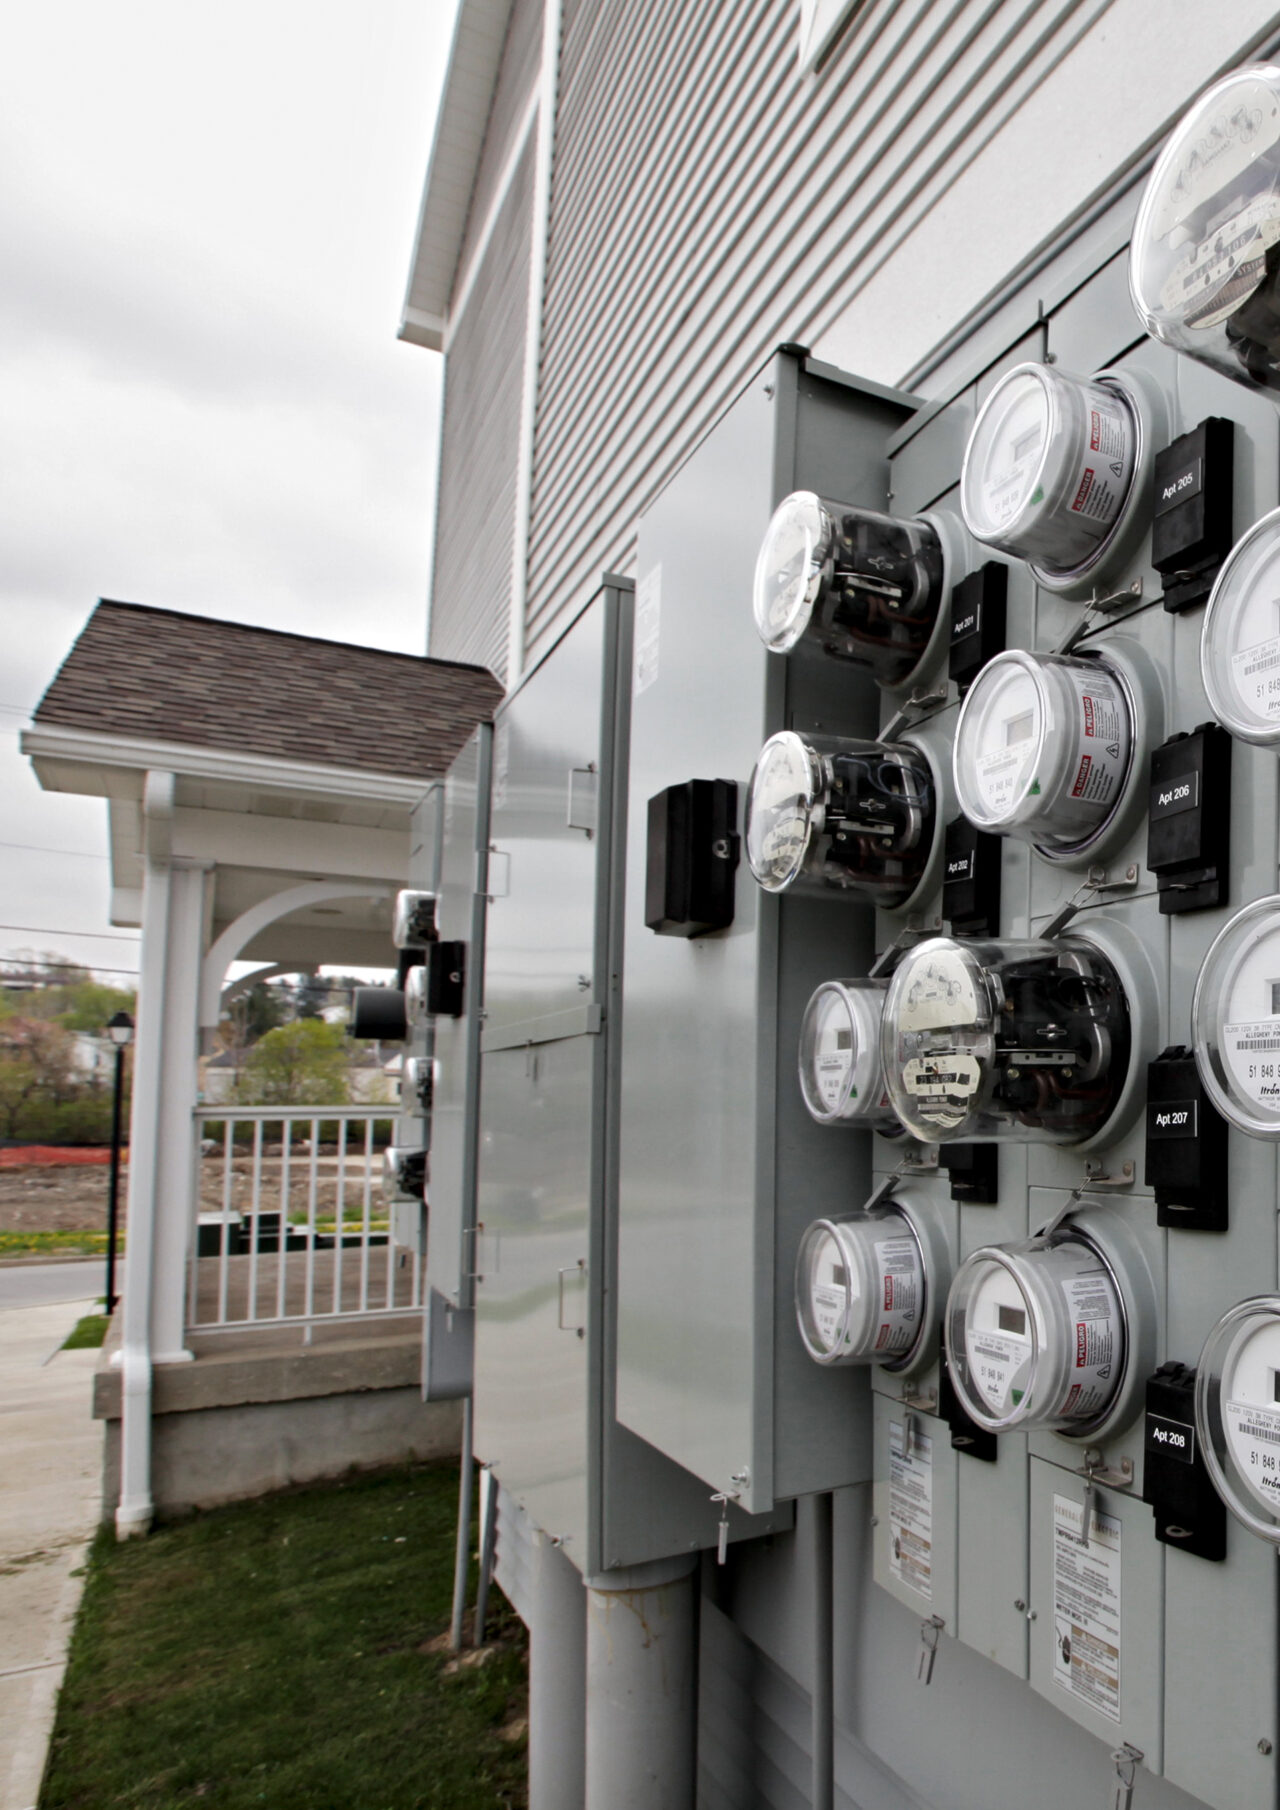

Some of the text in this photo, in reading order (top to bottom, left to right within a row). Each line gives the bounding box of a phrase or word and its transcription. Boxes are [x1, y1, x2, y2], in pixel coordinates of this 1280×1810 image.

[1162, 472, 1193, 500] Apt 205
[954, 616, 974, 633] Apt 201
[1257, 684, 1264, 698] 51
[1078, 758, 1091, 788] DANGER
[1158, 784, 1190, 805] Apt 206
[1249, 1065, 1257, 1078] 51
[1261, 1064, 1274, 1078] 848
[1156, 1112, 1188, 1127] Apt 207
[1076, 1325, 1086, 1358] PELIGRO
[1153, 1427, 1185, 1447] Apt 208
[1251, 1451, 1259, 1465] 51
[1262, 1455, 1275, 1470] 848
